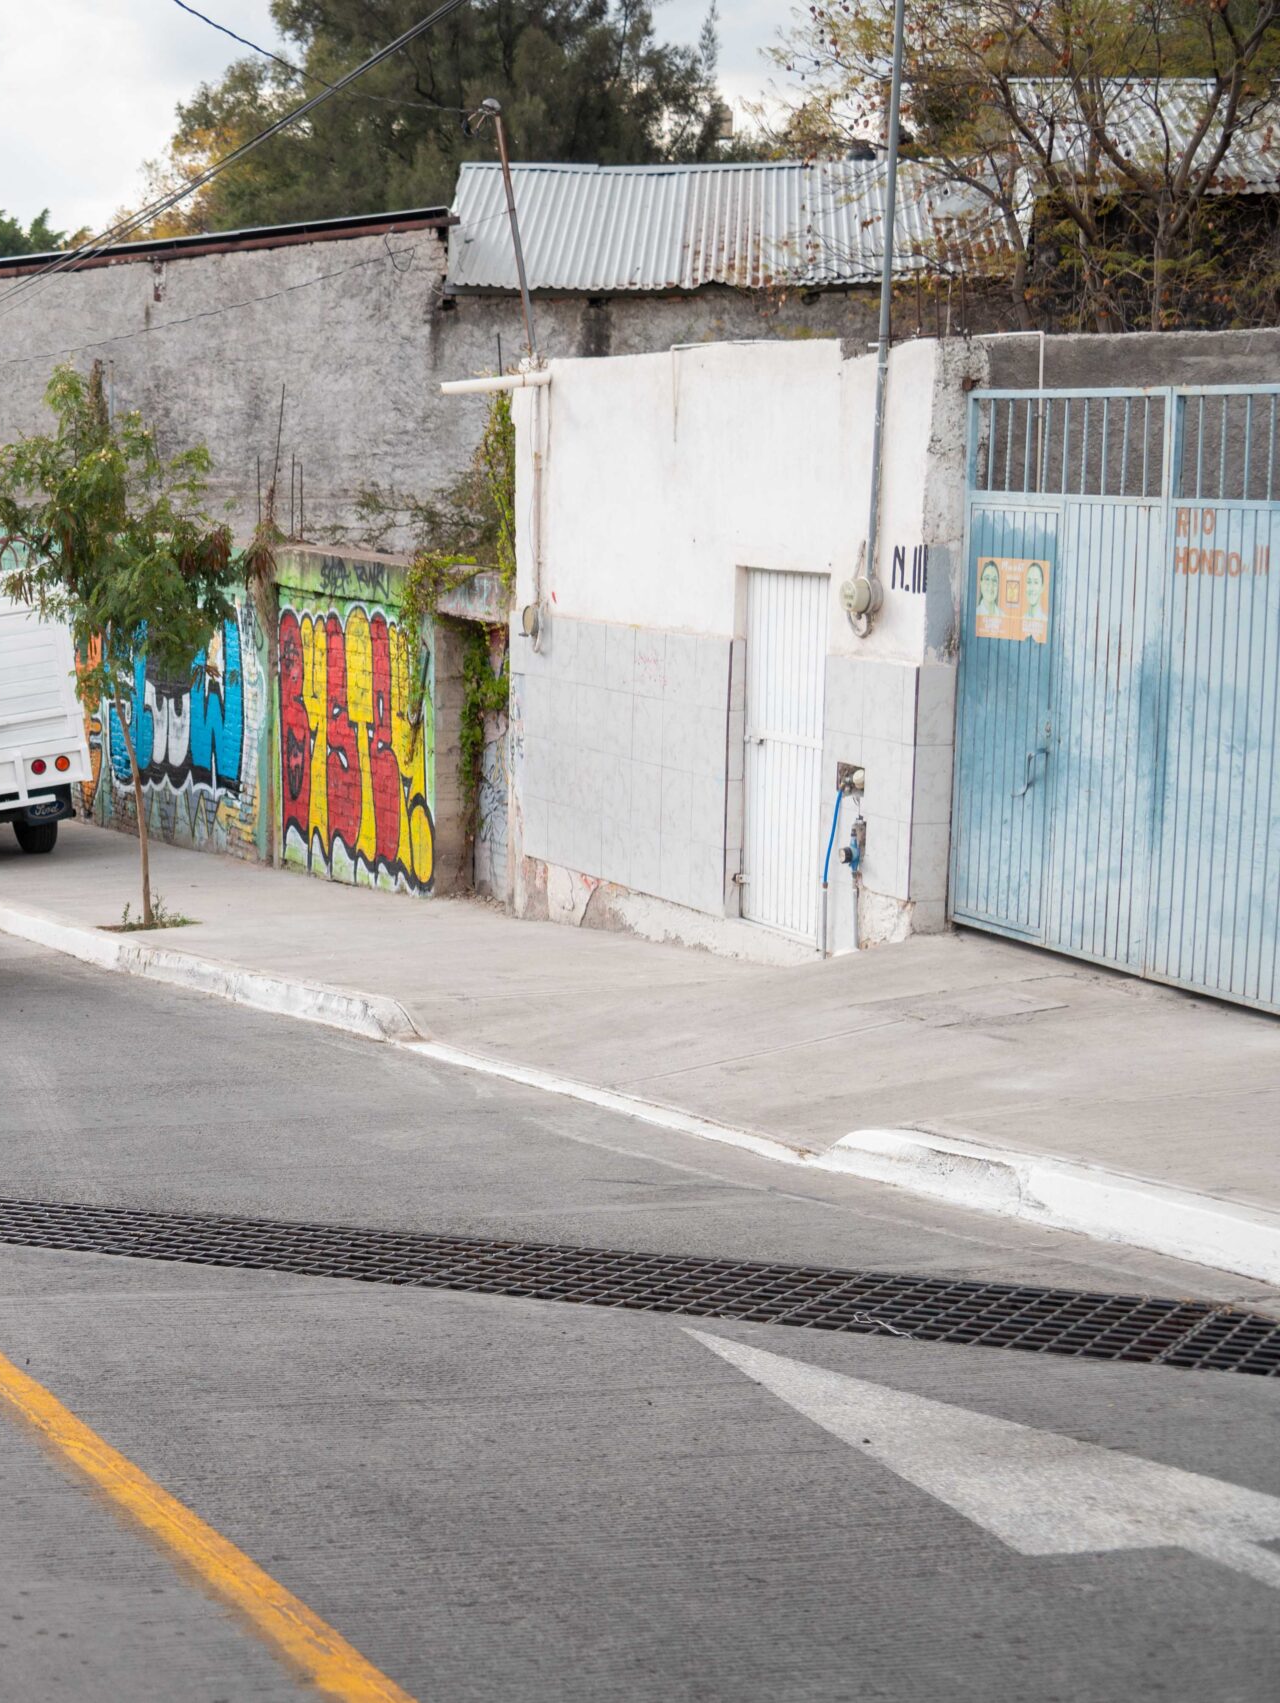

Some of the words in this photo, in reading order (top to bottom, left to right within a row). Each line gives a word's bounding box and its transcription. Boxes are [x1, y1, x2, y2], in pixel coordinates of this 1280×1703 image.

[1175, 507, 1216, 538] RIO
[1174, 546, 1241, 577] HONDO
[34, 804, 59, 816] Ford
